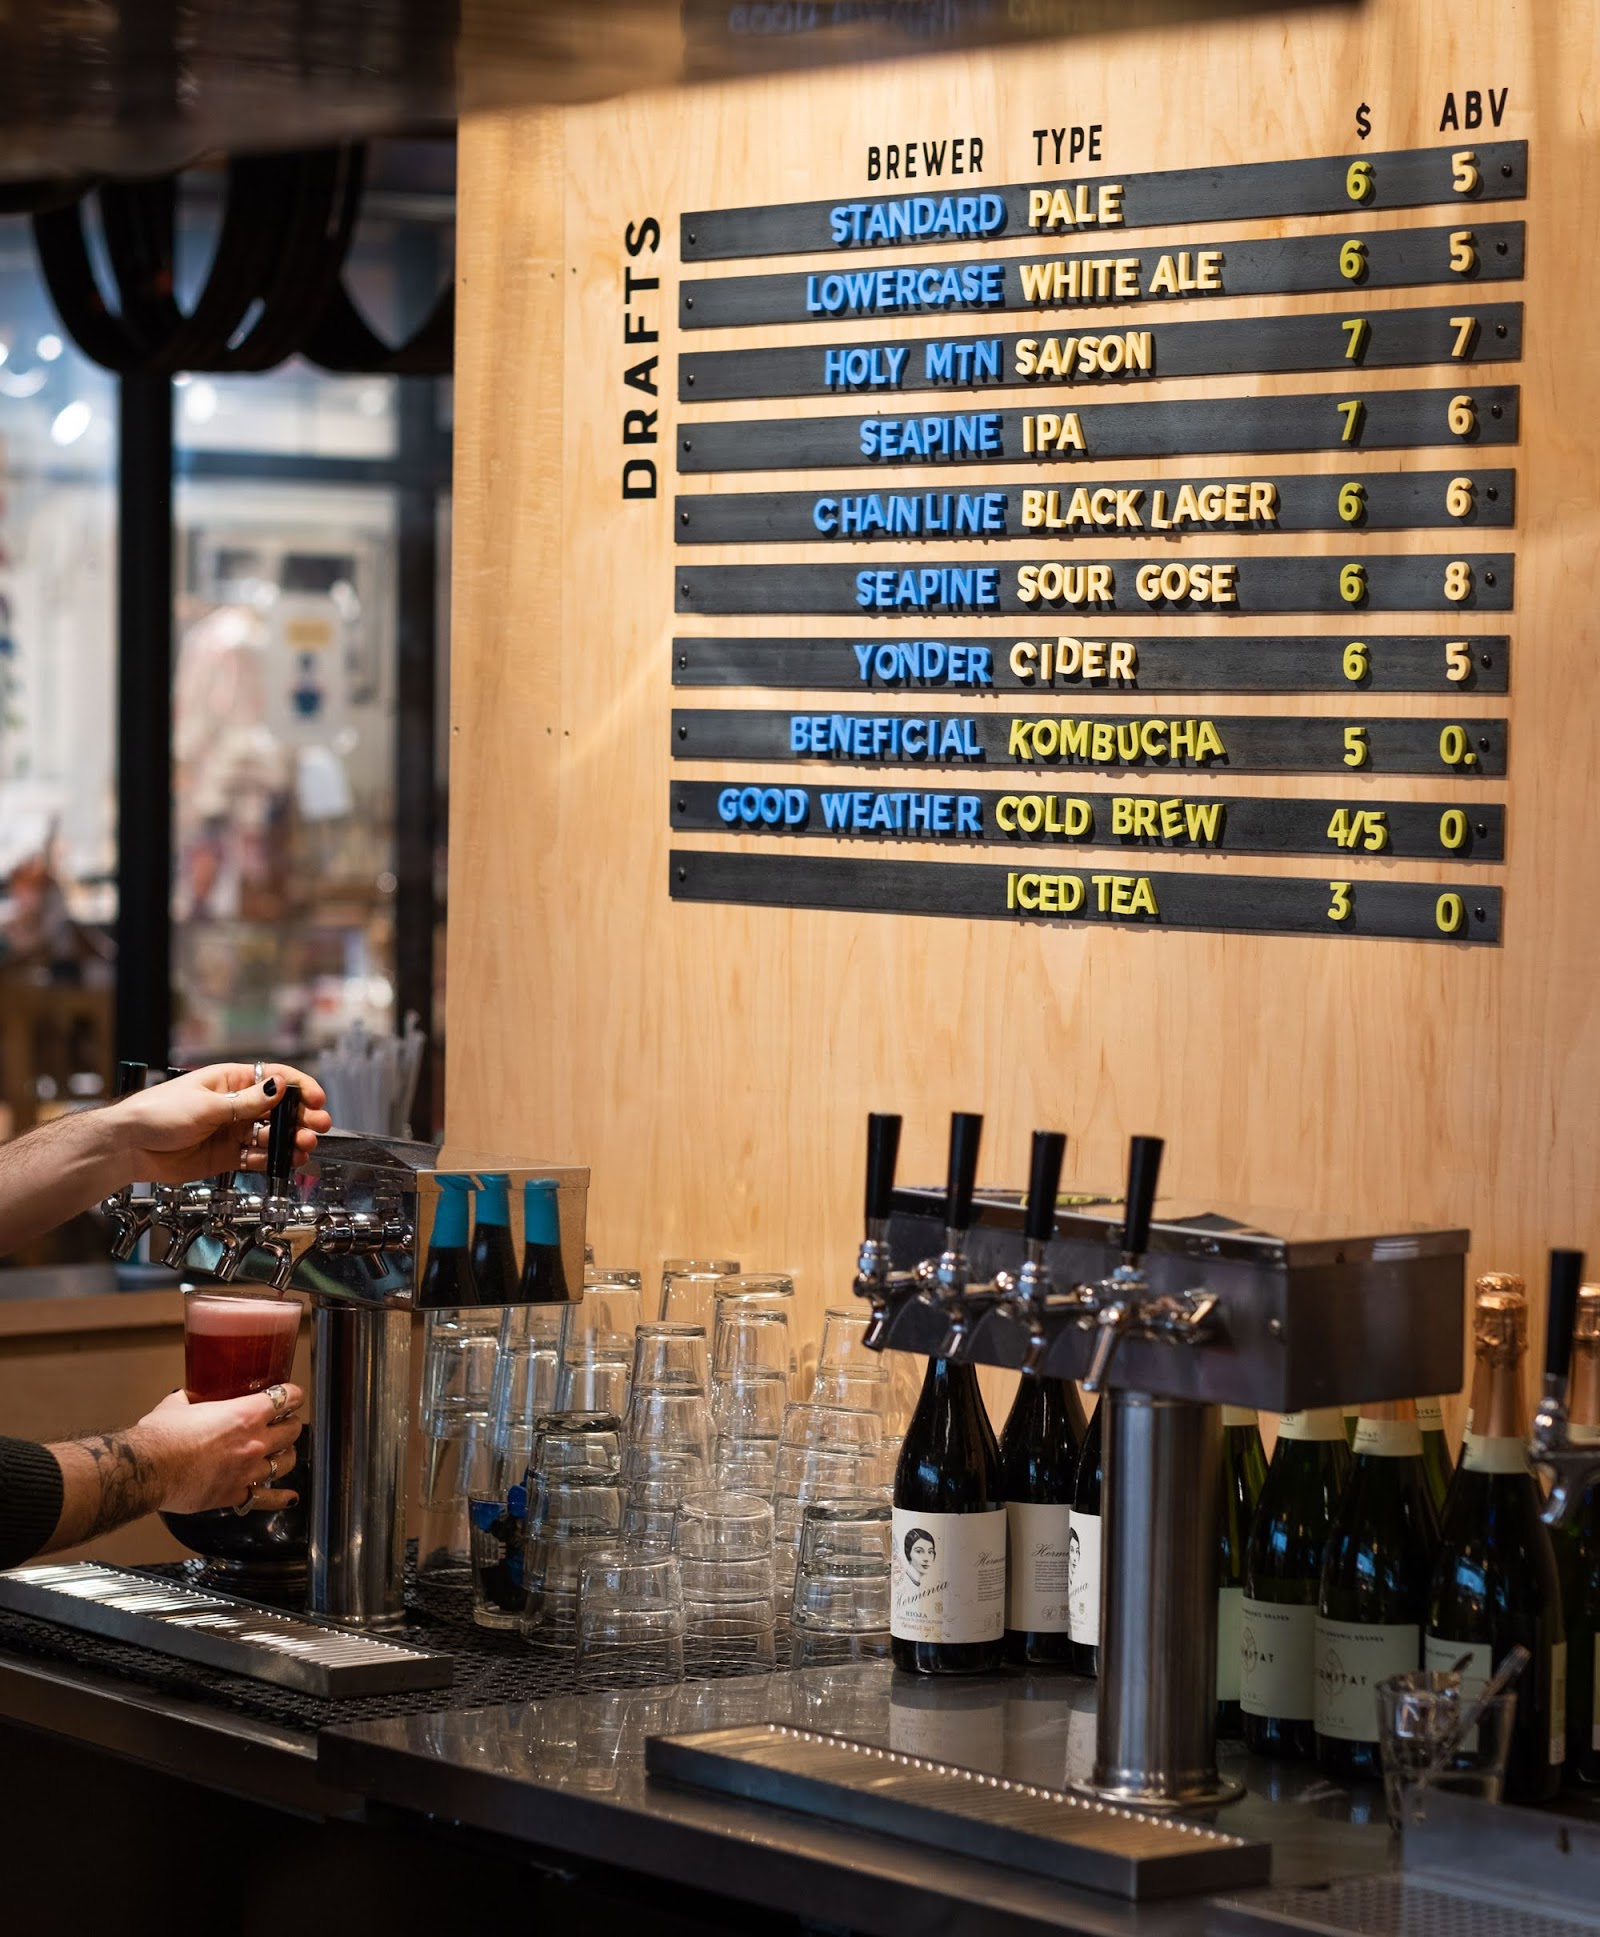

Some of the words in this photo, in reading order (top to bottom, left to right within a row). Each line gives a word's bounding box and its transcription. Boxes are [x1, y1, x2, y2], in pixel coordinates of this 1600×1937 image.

[868, 138, 982, 180] BREWER
[1033, 125, 1101, 165] TYPE
[1356, 103, 1370, 139] $
[1440, 88, 1507, 131] ABV
[830, 194, 1004, 243] STANDARD
[1028, 185, 1124, 230] PALE
[1347, 161, 1370, 199] 6
[1452, 151, 1476, 192] 5
[806, 264, 1003, 311] LOWERCASE
[1020, 259, 1140, 302] WHITE
[1149, 251, 1222, 293] ALE
[1340, 240, 1363, 278] 6
[1450, 231, 1472, 271] 5
[622, 216, 661, 500] DRAFTS
[824, 347, 907, 385] HOLY
[925, 339, 1000, 381] MTN
[1015, 330, 1152, 376] SAISON
[1342, 319, 1362, 358] 7
[1450, 317, 1474, 356] 7
[860, 413, 1001, 457] SEAPINE
[1023, 413, 1085, 452] IPA
[1338, 401, 1360, 440] 7
[1448, 395, 1472, 434] 6
[812, 492, 1006, 533] CHAINLINE
[1022, 488, 1143, 528] BLACK
[1151, 482, 1275, 528] LAGER
[1339, 482, 1362, 520] 6
[1446, 477, 1472, 516] 6
[855, 567, 998, 607] SEAPINE
[1017, 563, 1113, 603] SOUR
[1136, 563, 1235, 602] GOSE
[1340, 564, 1362, 601] 6
[1444, 561, 1469, 600] 8
[853, 641, 992, 683] YONDER
[1010, 636, 1136, 680] CIDER
[1343, 643, 1367, 680] 6
[1446, 642, 1470, 680] 5
[790, 714, 981, 755] BENEFICIAL
[1009, 719, 1225, 761] KOMBUCHA
[1344, 727, 1365, 766] 5
[718, 787, 809, 823] GOOD
[820, 792, 982, 831] WEATHER
[996, 794, 1093, 836] COLD
[1112, 797, 1224, 842] BREW
[1327, 809, 1385, 850] 4/5
[1440, 810, 1463, 848] 0
[1007, 873, 1084, 911] ICED
[1092, 875, 1155, 914] TEA
[1327, 881, 1353, 921] 3
[1436, 893, 1459, 931] 0
